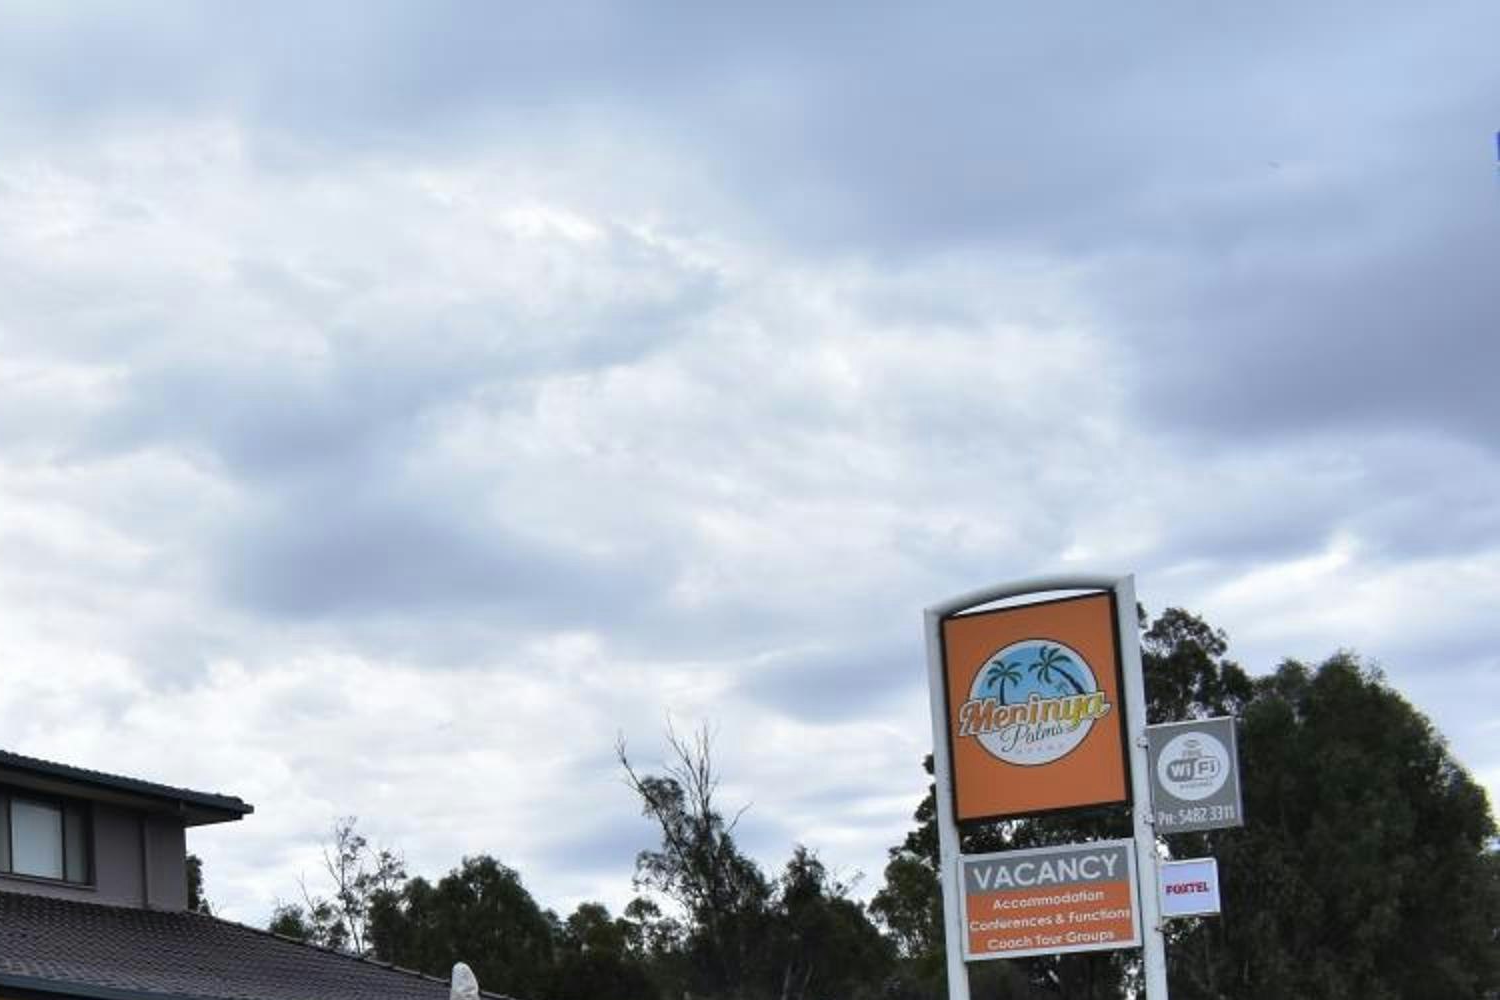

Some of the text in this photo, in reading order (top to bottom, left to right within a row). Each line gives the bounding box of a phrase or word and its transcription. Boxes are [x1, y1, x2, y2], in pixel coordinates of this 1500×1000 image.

[1000, 721, 1063, 752] Palms
[973, 853, 1118, 890] VACANCY
[1165, 881, 1209, 896] FOXTEL
[993, 890, 1105, 909] Accommodation
[970, 917, 1053, 931] Conferences
[1055, 913, 1065, 924] &
[987, 931, 1114, 949] Coach Tour Groups
